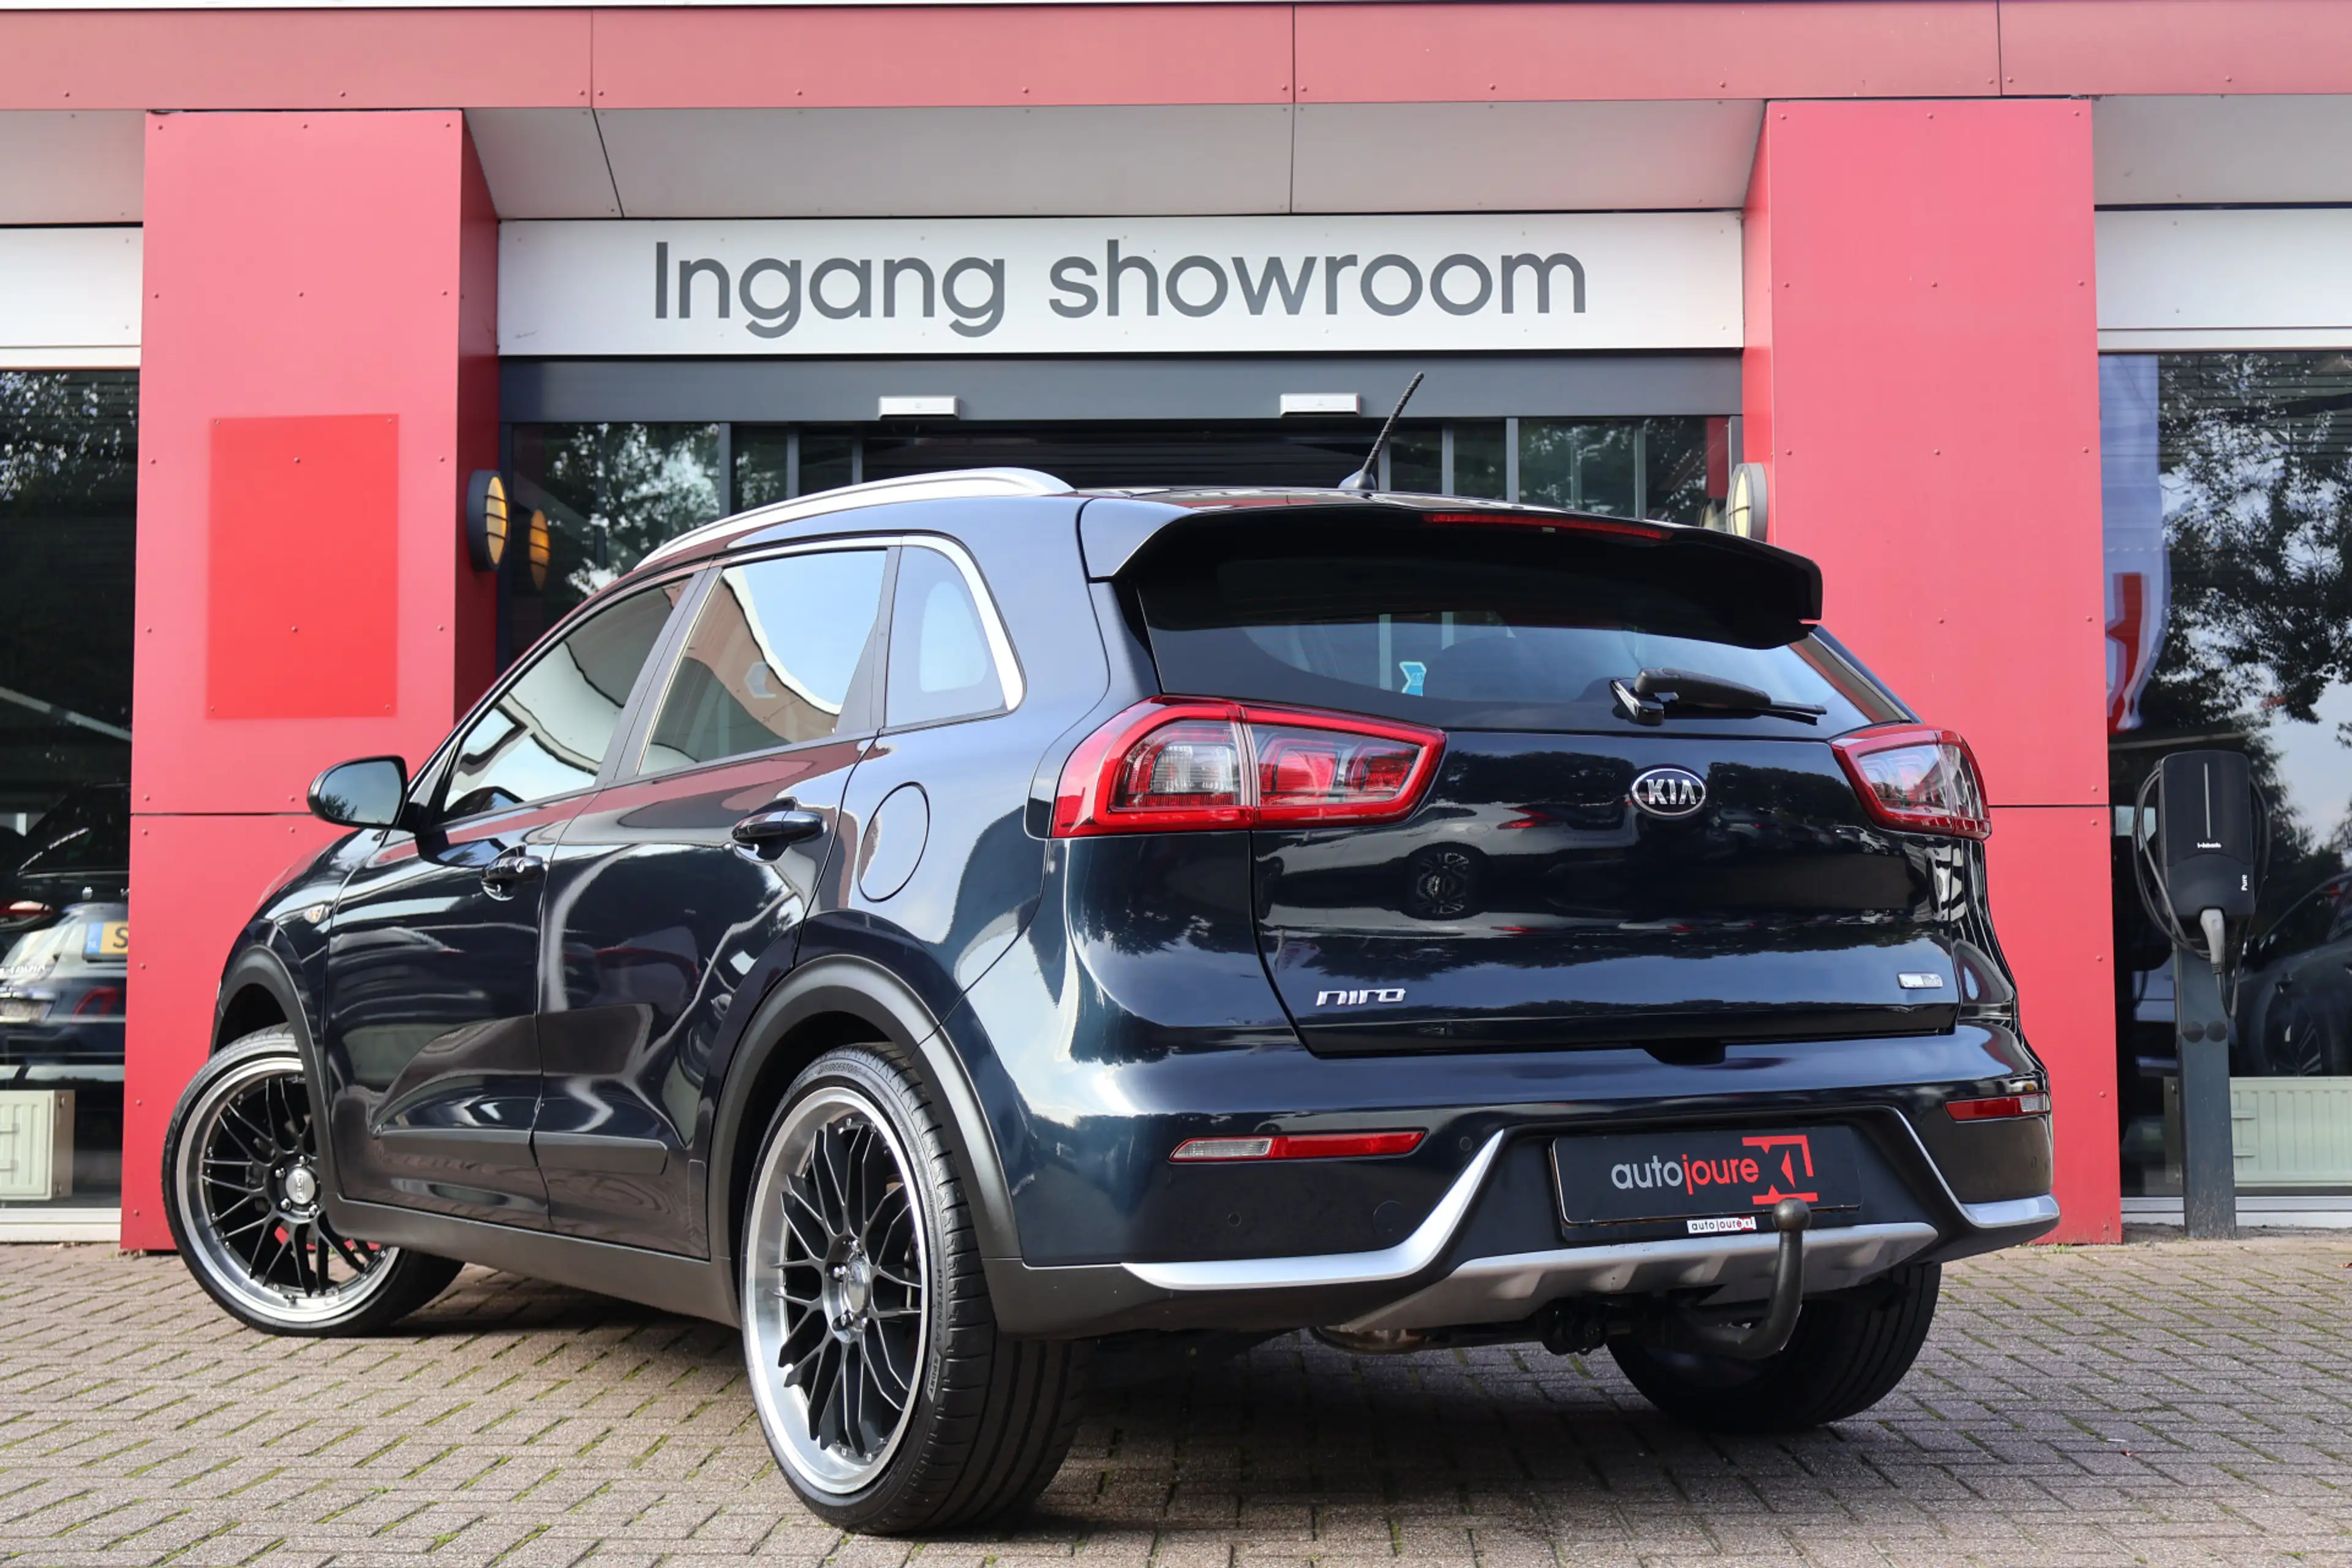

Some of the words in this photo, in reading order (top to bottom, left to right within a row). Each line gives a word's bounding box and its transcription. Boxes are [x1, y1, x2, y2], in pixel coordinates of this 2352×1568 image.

[655, 241, 1006, 338] Ingang
[1049, 239, 1586, 319] showroom
[1646, 779, 1697, 805] KIA
[1610, 1154, 1760, 1195] autojoure
